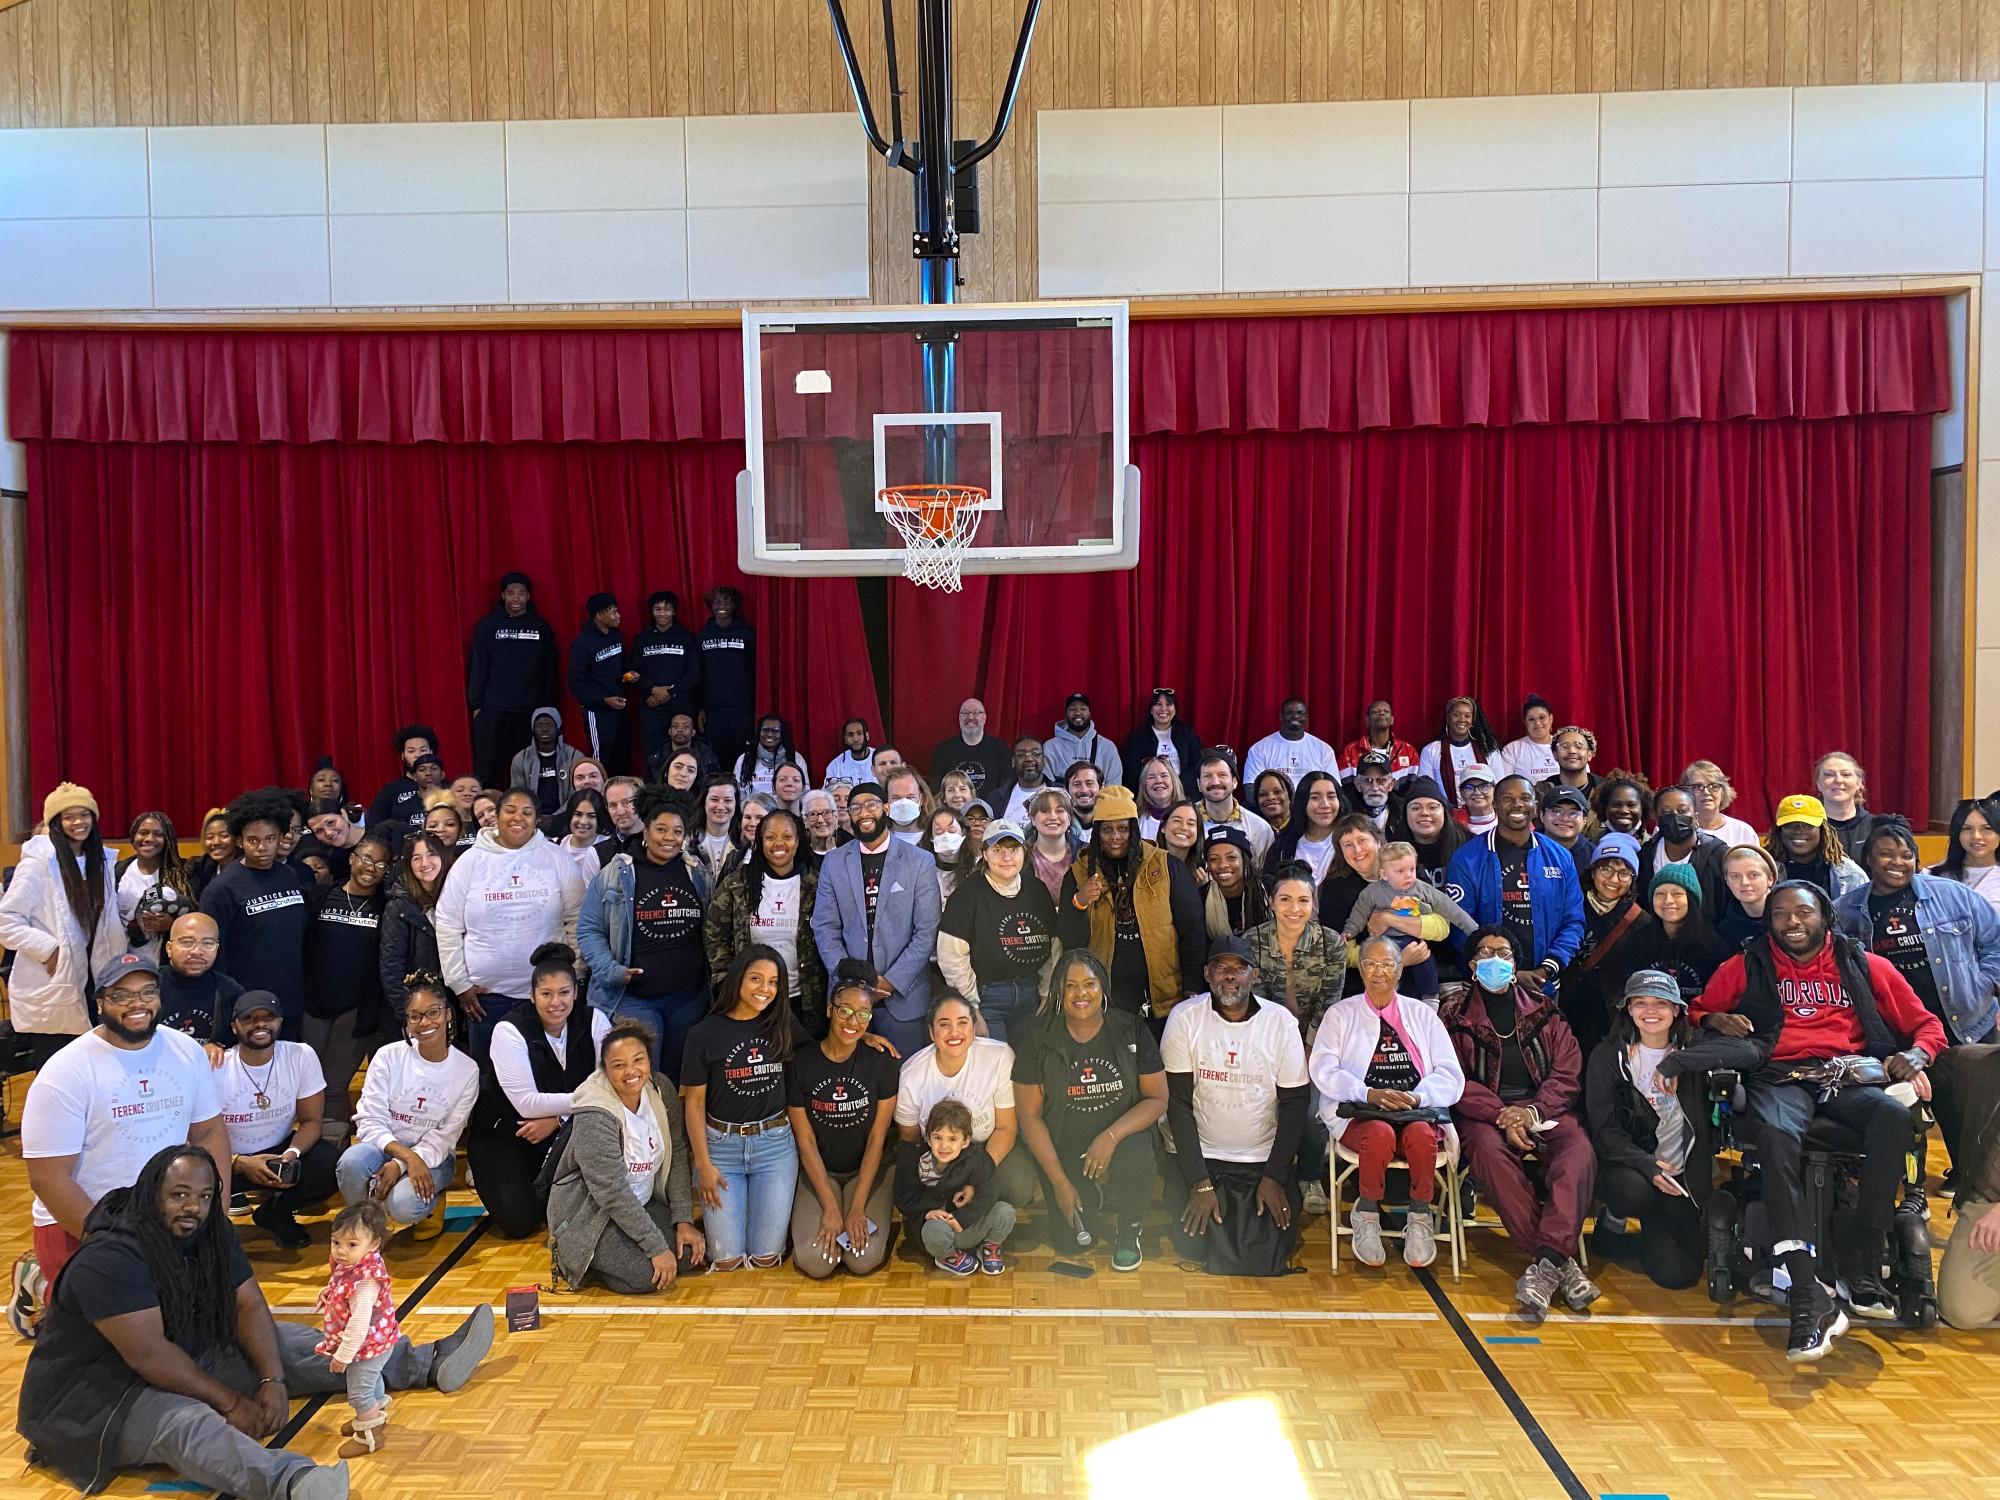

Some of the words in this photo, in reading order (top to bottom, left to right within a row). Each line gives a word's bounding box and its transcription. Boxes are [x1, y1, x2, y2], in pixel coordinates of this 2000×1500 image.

[245, 891, 283, 906] JUSTICE
[484, 891, 513, 902] TERENCE
[514, 888, 550, 900] CRUTCHER
[320, 907, 362, 918] JUSTICE
[635, 909, 667, 920] TERENCE
[667, 908, 701, 918] CRUTCHER
[750, 917, 775, 927] ERENCE
[724, 1066, 753, 1079] TERENCE
[753, 1062, 783, 1075] CRUTCHER
[1084, 1058, 1121, 1079] ATTITUDE
[1198, 1068, 1229, 1082] TERENCE
[1229, 1073, 1264, 1084] CRUTCHER
[741, 1076, 770, 1084] FOUNDATION
[1067, 1085, 1086, 1096] ENCE
[1086, 1079, 1124, 1094] CRUTCHER
[111, 1102, 145, 1119] TERENCE
[145, 1095, 184, 1113] CRUTCHER
[811, 1099, 837, 1112] TERENCE
[838, 1096, 870, 1112] CRUTCHER
[971, 1111, 990, 1128] CHER
[628, 1161, 654, 1173] TERENC
